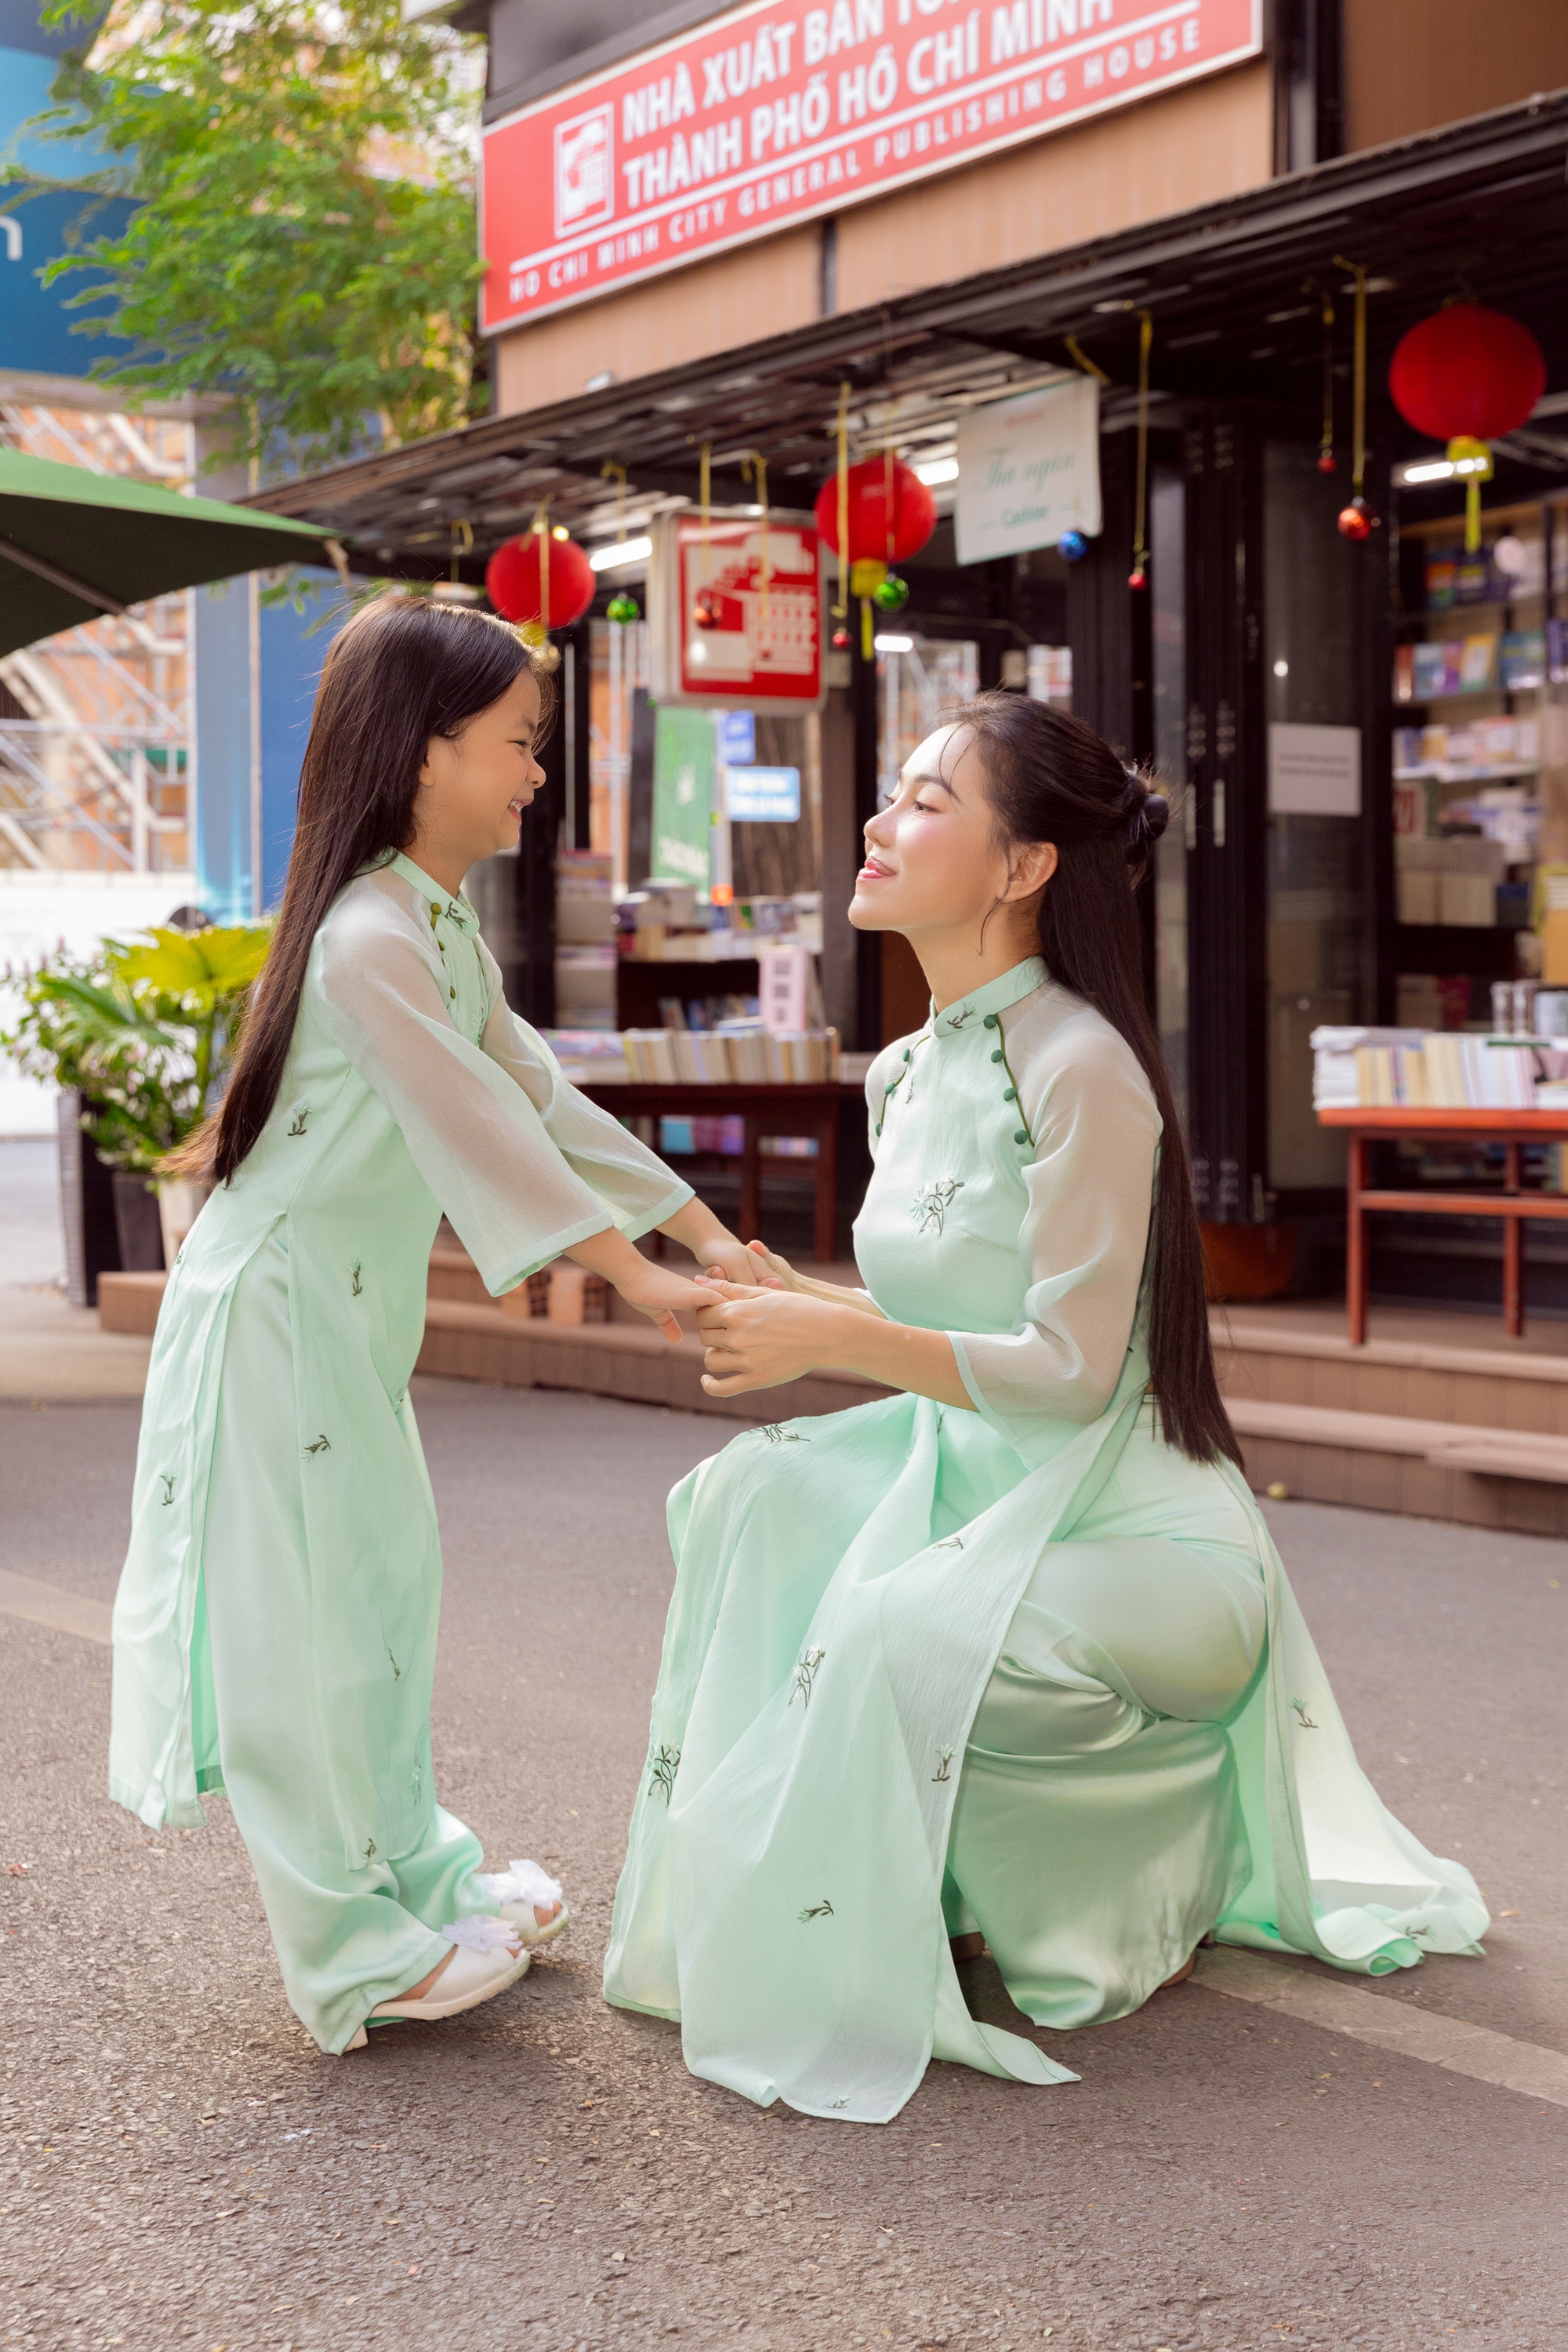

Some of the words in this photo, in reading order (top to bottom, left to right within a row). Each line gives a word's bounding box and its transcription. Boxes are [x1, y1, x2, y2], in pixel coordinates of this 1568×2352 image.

[510, 270, 540, 303] HO
[549, 251, 588, 289] CHI
[597, 224, 659, 271] MINH
[669, 197, 727, 244] CITY
[738, 148, 862, 217] GENERAL
[874, 68, 1067, 167] PUBLISHING
[1083, 18, 1200, 89] HOUSE
[622, 61, 696, 143] NHÀ
[702, 20, 797, 110] XUẤT
[622, 115, 742, 209] THÀNH
[750, 70, 830, 162] PHỐ
[906, 8, 980, 96] CHÍ
